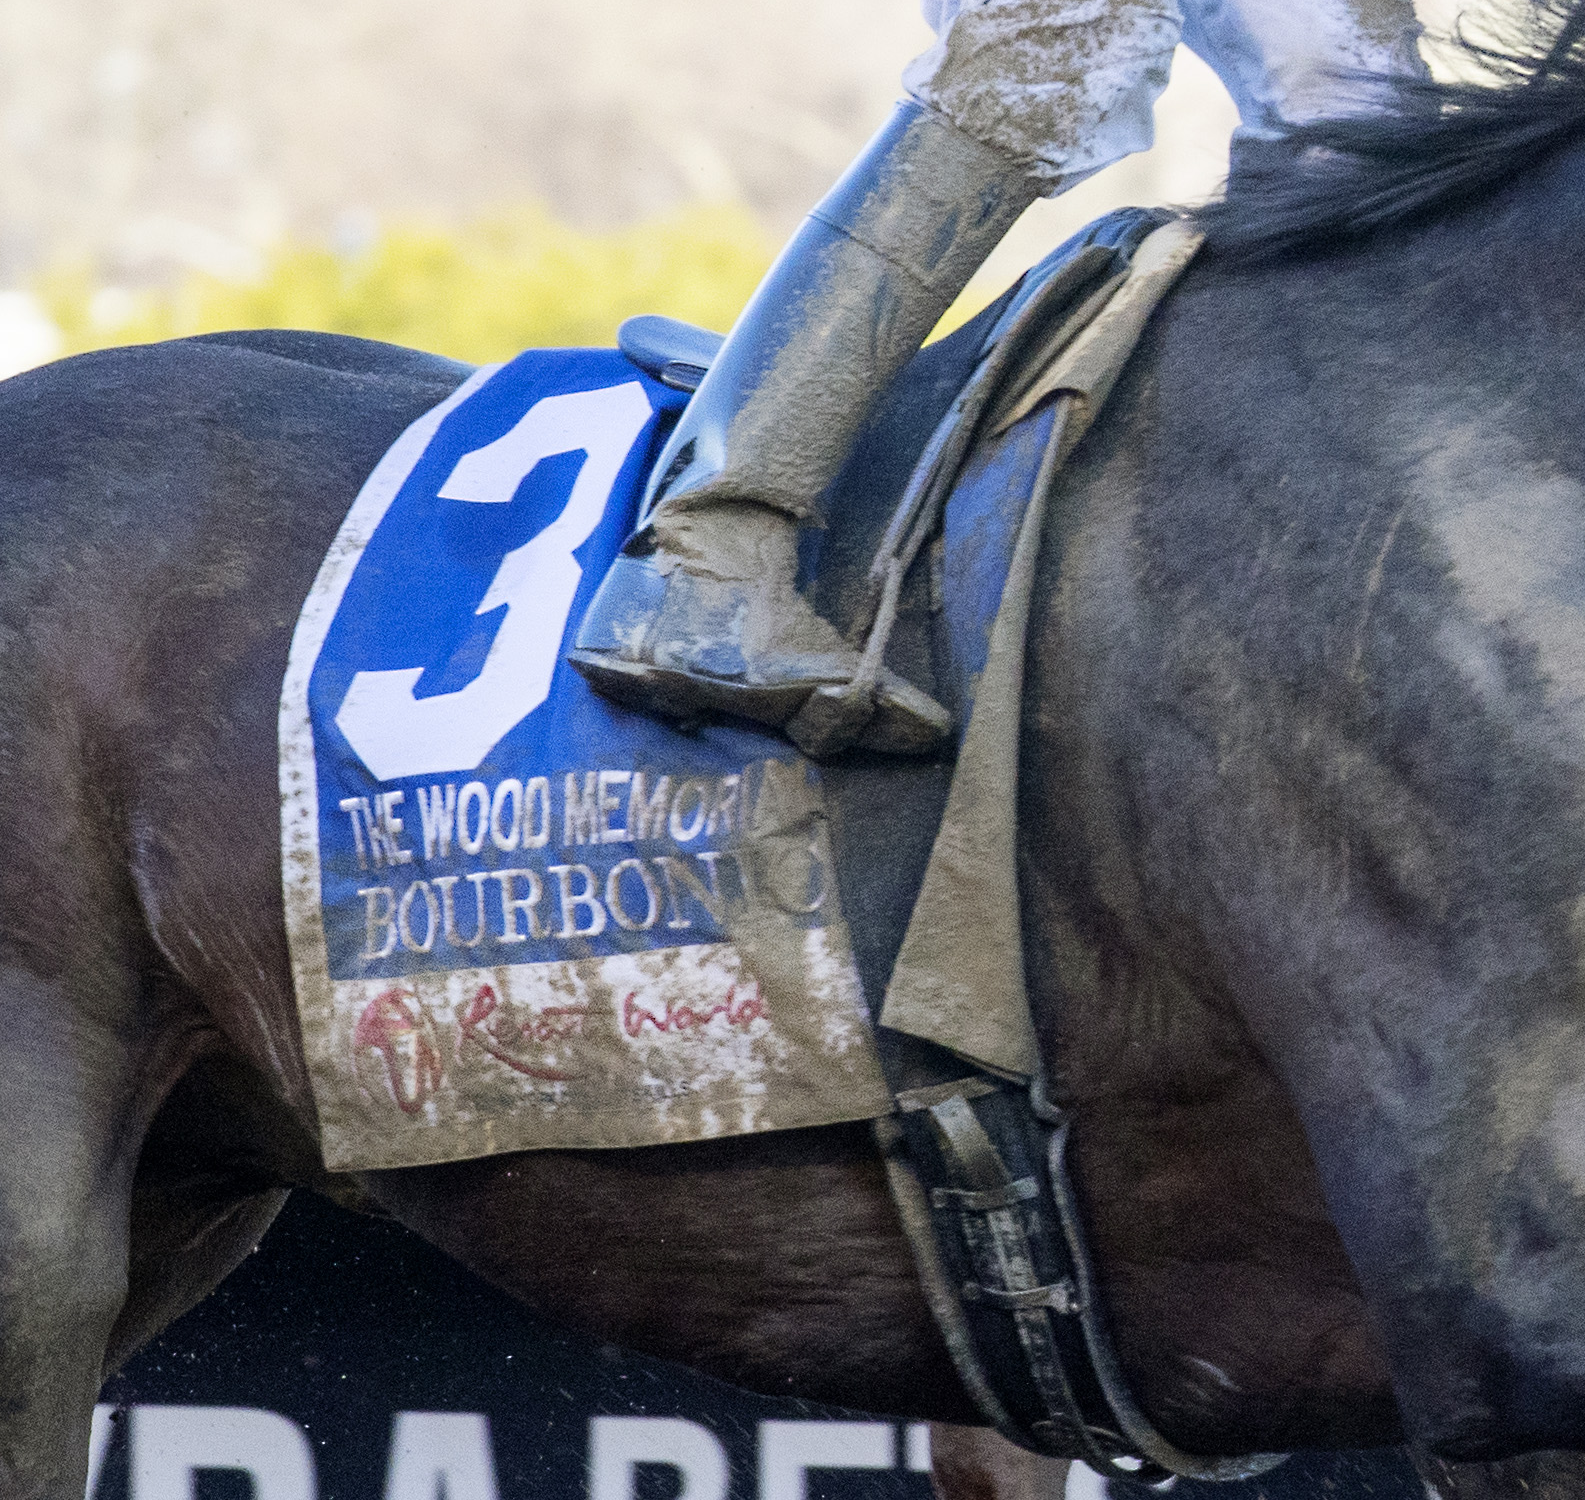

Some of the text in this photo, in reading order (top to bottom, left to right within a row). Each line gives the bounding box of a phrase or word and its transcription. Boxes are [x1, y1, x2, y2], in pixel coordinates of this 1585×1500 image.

[335, 380, 654, 782] 3
[339, 790, 413, 870] THE
[416, 776, 551, 861] WOOD
